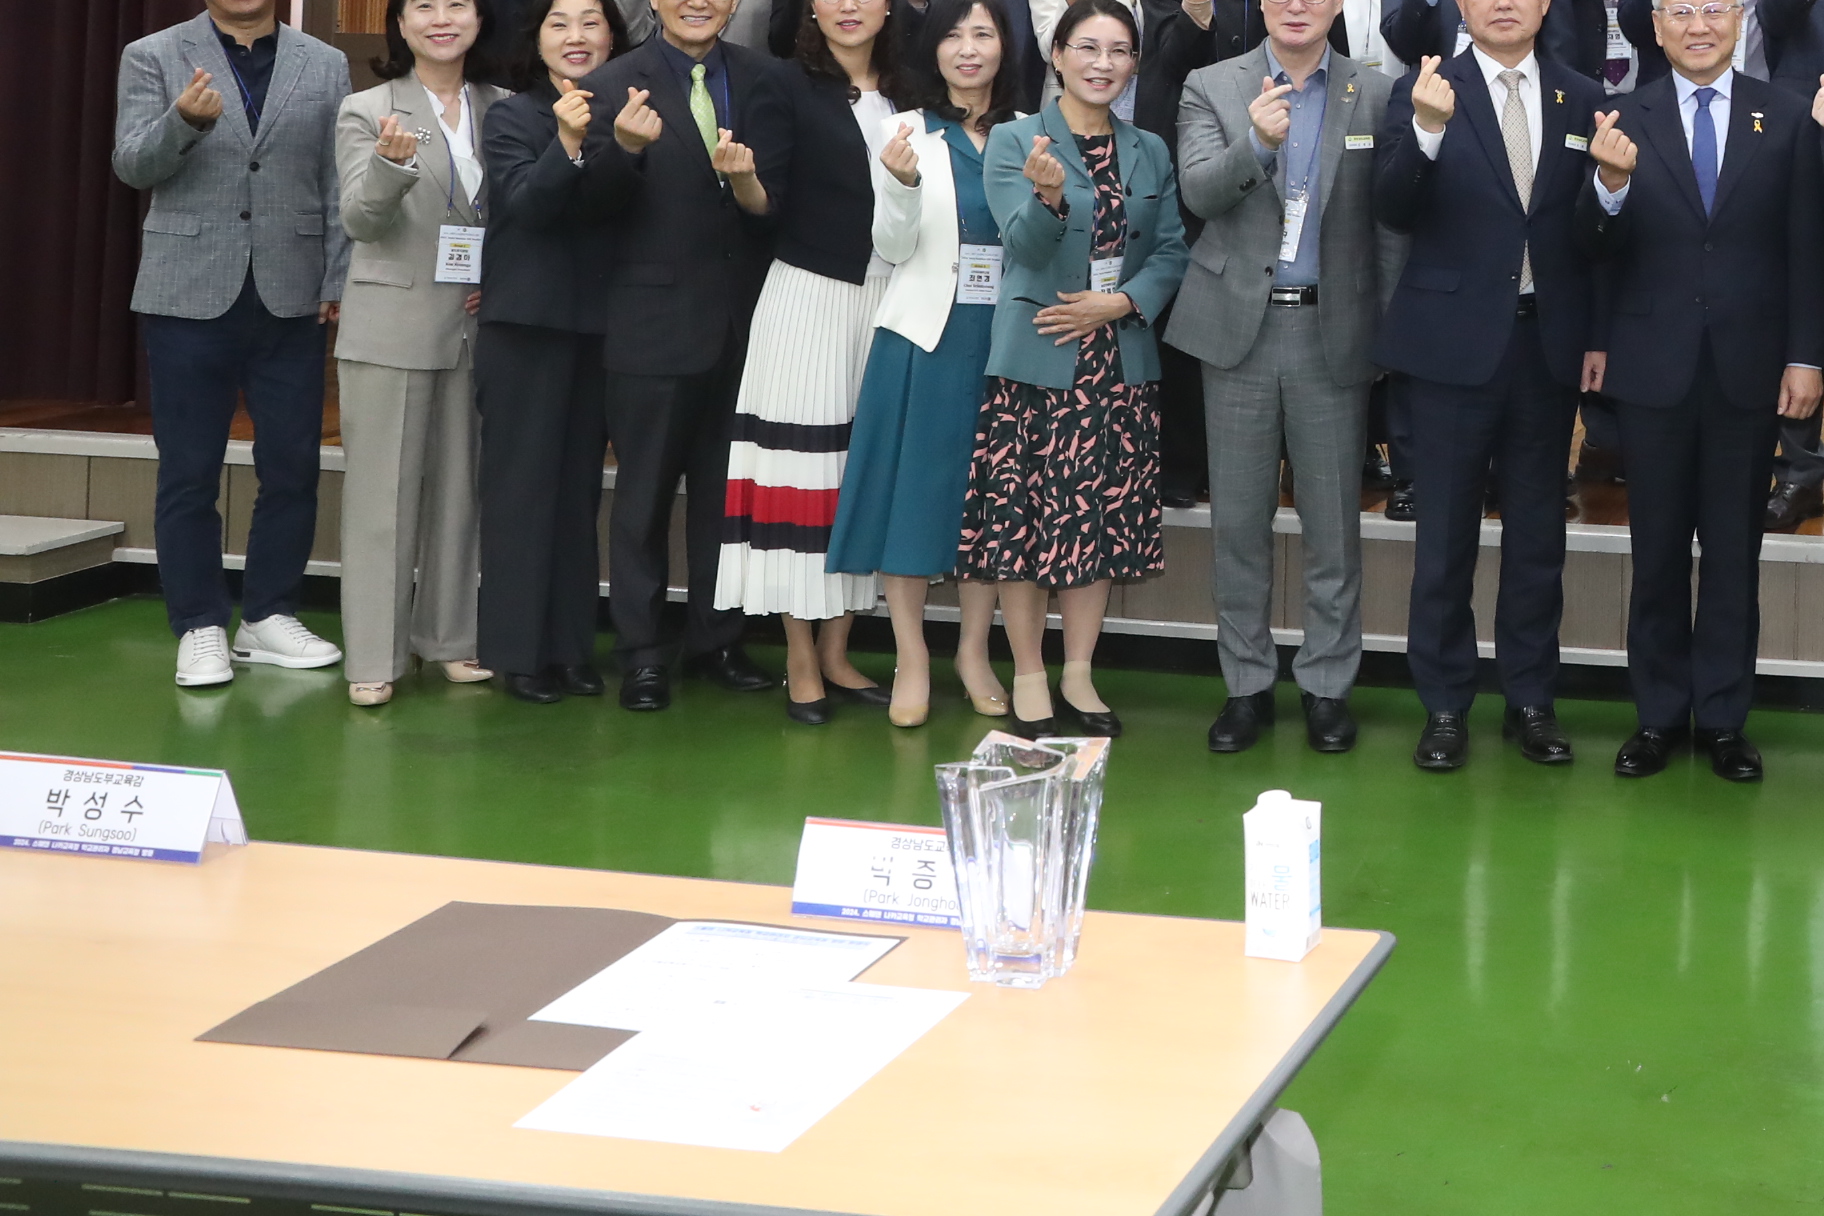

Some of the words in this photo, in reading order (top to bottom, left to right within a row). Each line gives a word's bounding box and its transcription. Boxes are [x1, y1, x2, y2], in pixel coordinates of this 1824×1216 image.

[63, 769, 145, 788] 경상남도부교육감
[38, 819, 72, 836] (Park
[78, 823, 137, 842] Sungsoo)
[891, 836, 950, 853] 경상남도교
[864, 888, 899, 905] (Park
[1250, 891, 1291, 911] WATER
